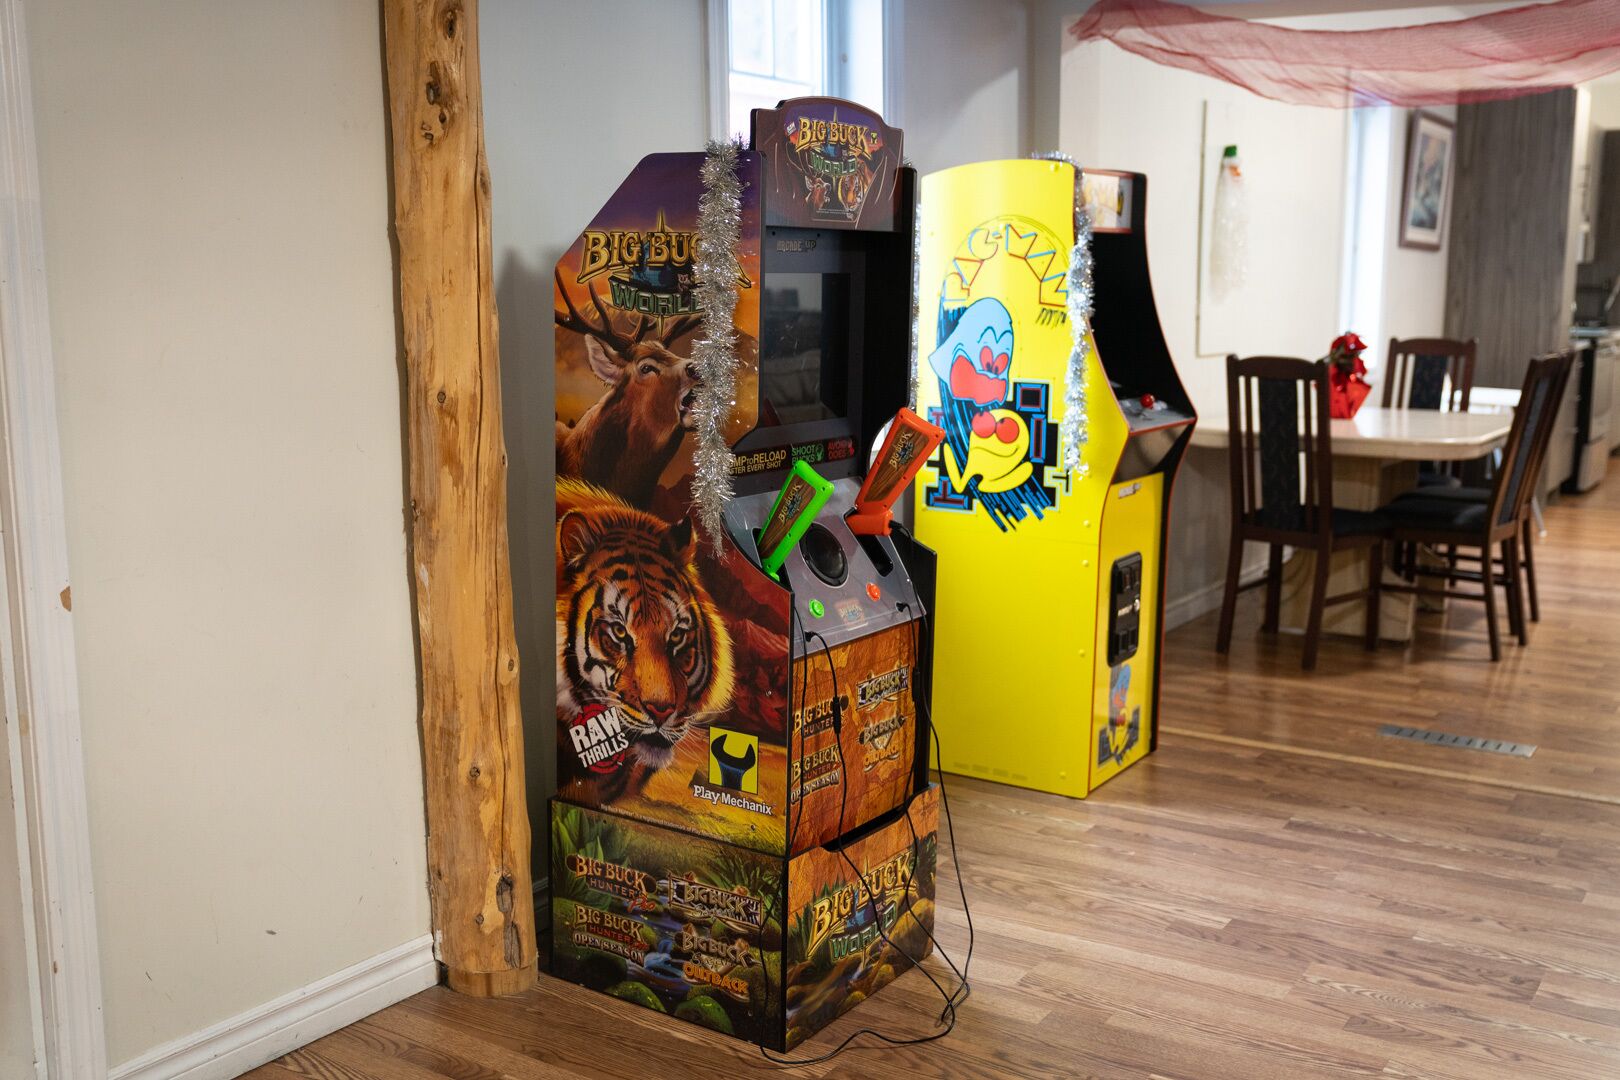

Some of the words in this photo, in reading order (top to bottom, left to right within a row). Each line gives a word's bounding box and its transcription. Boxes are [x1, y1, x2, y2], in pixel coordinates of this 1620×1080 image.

[795, 117, 827, 152] BIG
[828, 121, 872, 160] BUCK
[811, 152, 858, 177] WORLD
[577, 231, 642, 284] BIG
[753, 449, 787, 464] RELOAD
[791, 444, 816, 456] SHOOT
[828, 448, 847, 459] DOES
[746, 463, 765, 473] EVERY
[766, 460, 782, 470] SHOT
[865, 682, 880, 703] BIG
[879, 674, 901, 692] BUCK
[569, 706, 623, 753] RAW
[792, 706, 813, 736] BIG
[863, 725, 879, 746] BIG
[879, 716, 901, 734] BUCK
[578, 733, 630, 769] THRILLS
[791, 756, 811, 784] BG
[812, 744, 840, 769] BUCK
[811, 770, 840, 792] SEASON
[693, 784, 722, 806] Play
[721, 792, 773, 816] Mechanix
[576, 854, 602, 879] BIG
[605, 861, 648, 896] BUCK
[590, 878, 636, 899] HUNTER
[684, 883, 708, 903] BIG
[708, 888, 748, 920] BUCK
[807, 882, 854, 957] BIG
[857, 850, 918, 909] BUCK
[575, 905, 602, 928] BIG
[603, 911, 645, 942] BUCK
[589, 925, 631, 944] HUNTER
[829, 899, 898, 962] WORLD
[574, 932, 602, 951] OPEN
[602, 940, 645, 967] SEASON
[682, 930, 707, 952] BIG
[707, 937, 750, 969] BUCK
[682, 962, 749, 993] OUTBACK
